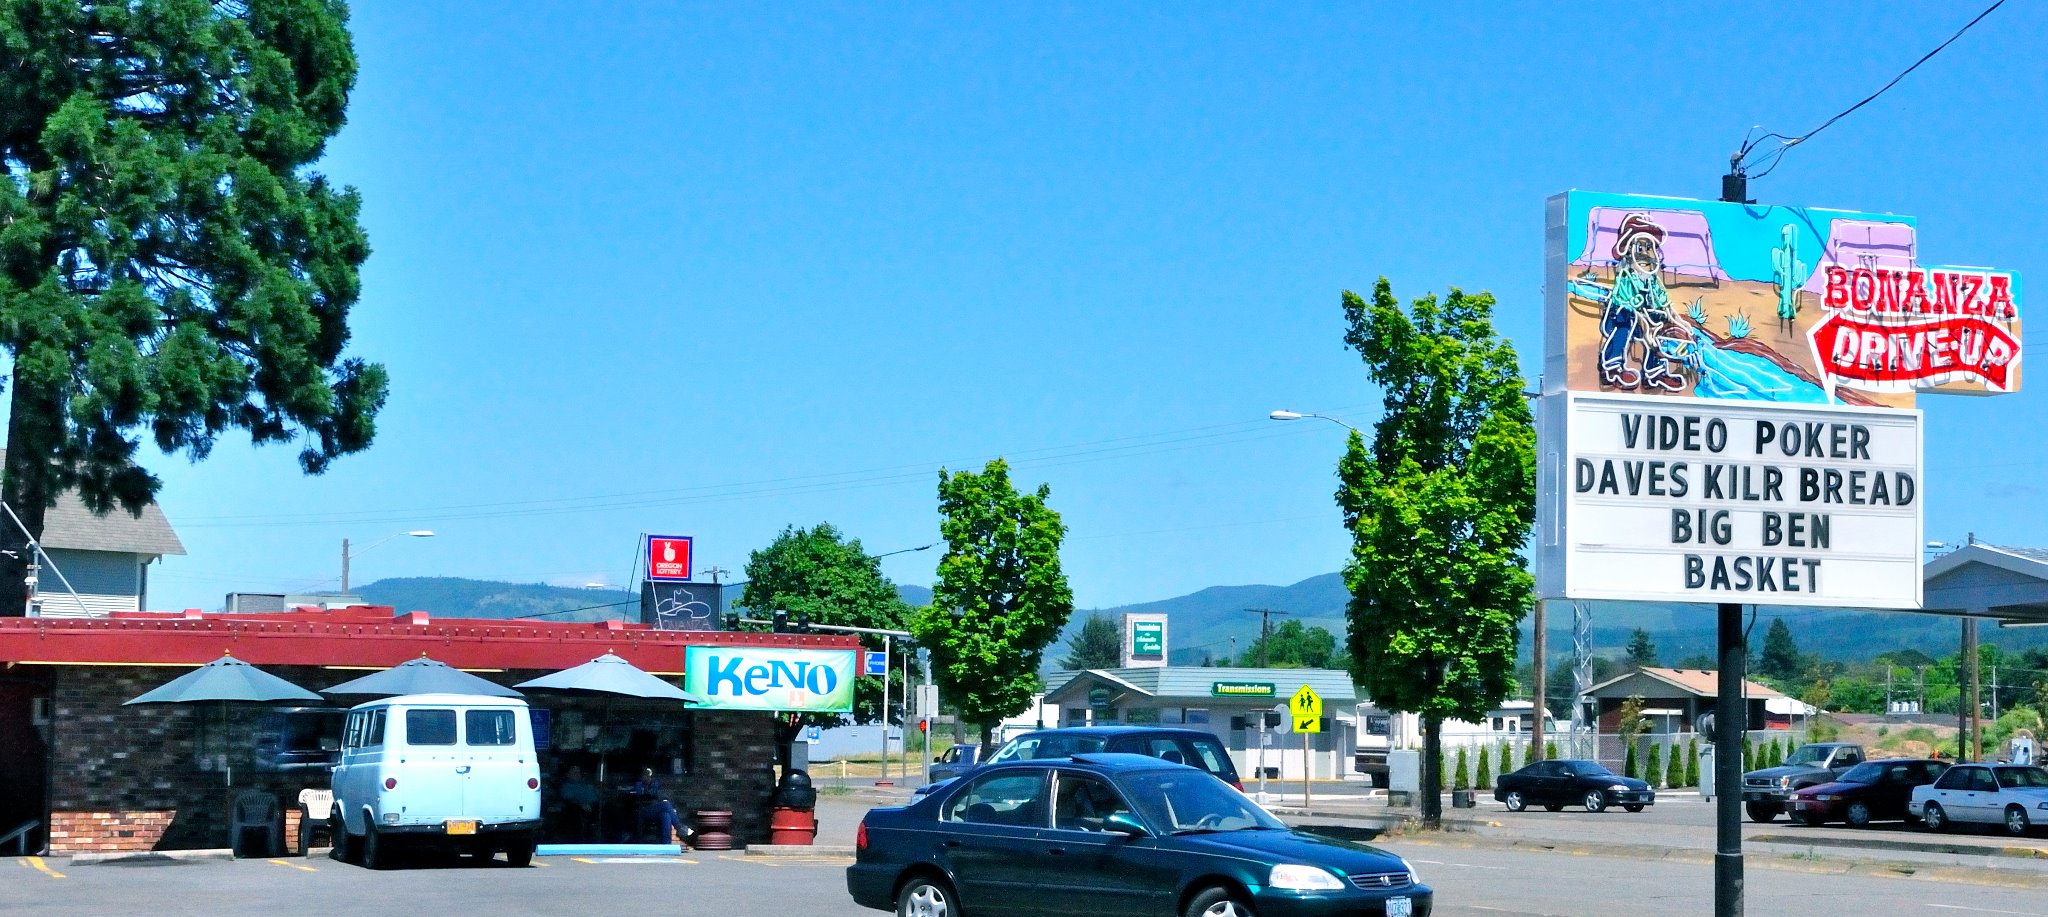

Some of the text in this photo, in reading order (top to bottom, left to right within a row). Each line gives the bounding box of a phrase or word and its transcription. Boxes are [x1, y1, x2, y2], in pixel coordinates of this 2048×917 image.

[1824, 265, 2015, 319] BONANZA
[1832, 325, 2011, 371] DRIVE-UP
[1620, 413, 1871, 460] VIDEO POKER
[1575, 457, 1915, 506] DAVES KILR BREAD
[1671, 509, 1831, 550] BIG BEN
[1685, 555, 1822, 594] BASKET
[1217, 684, 1271, 694] Transmissions
